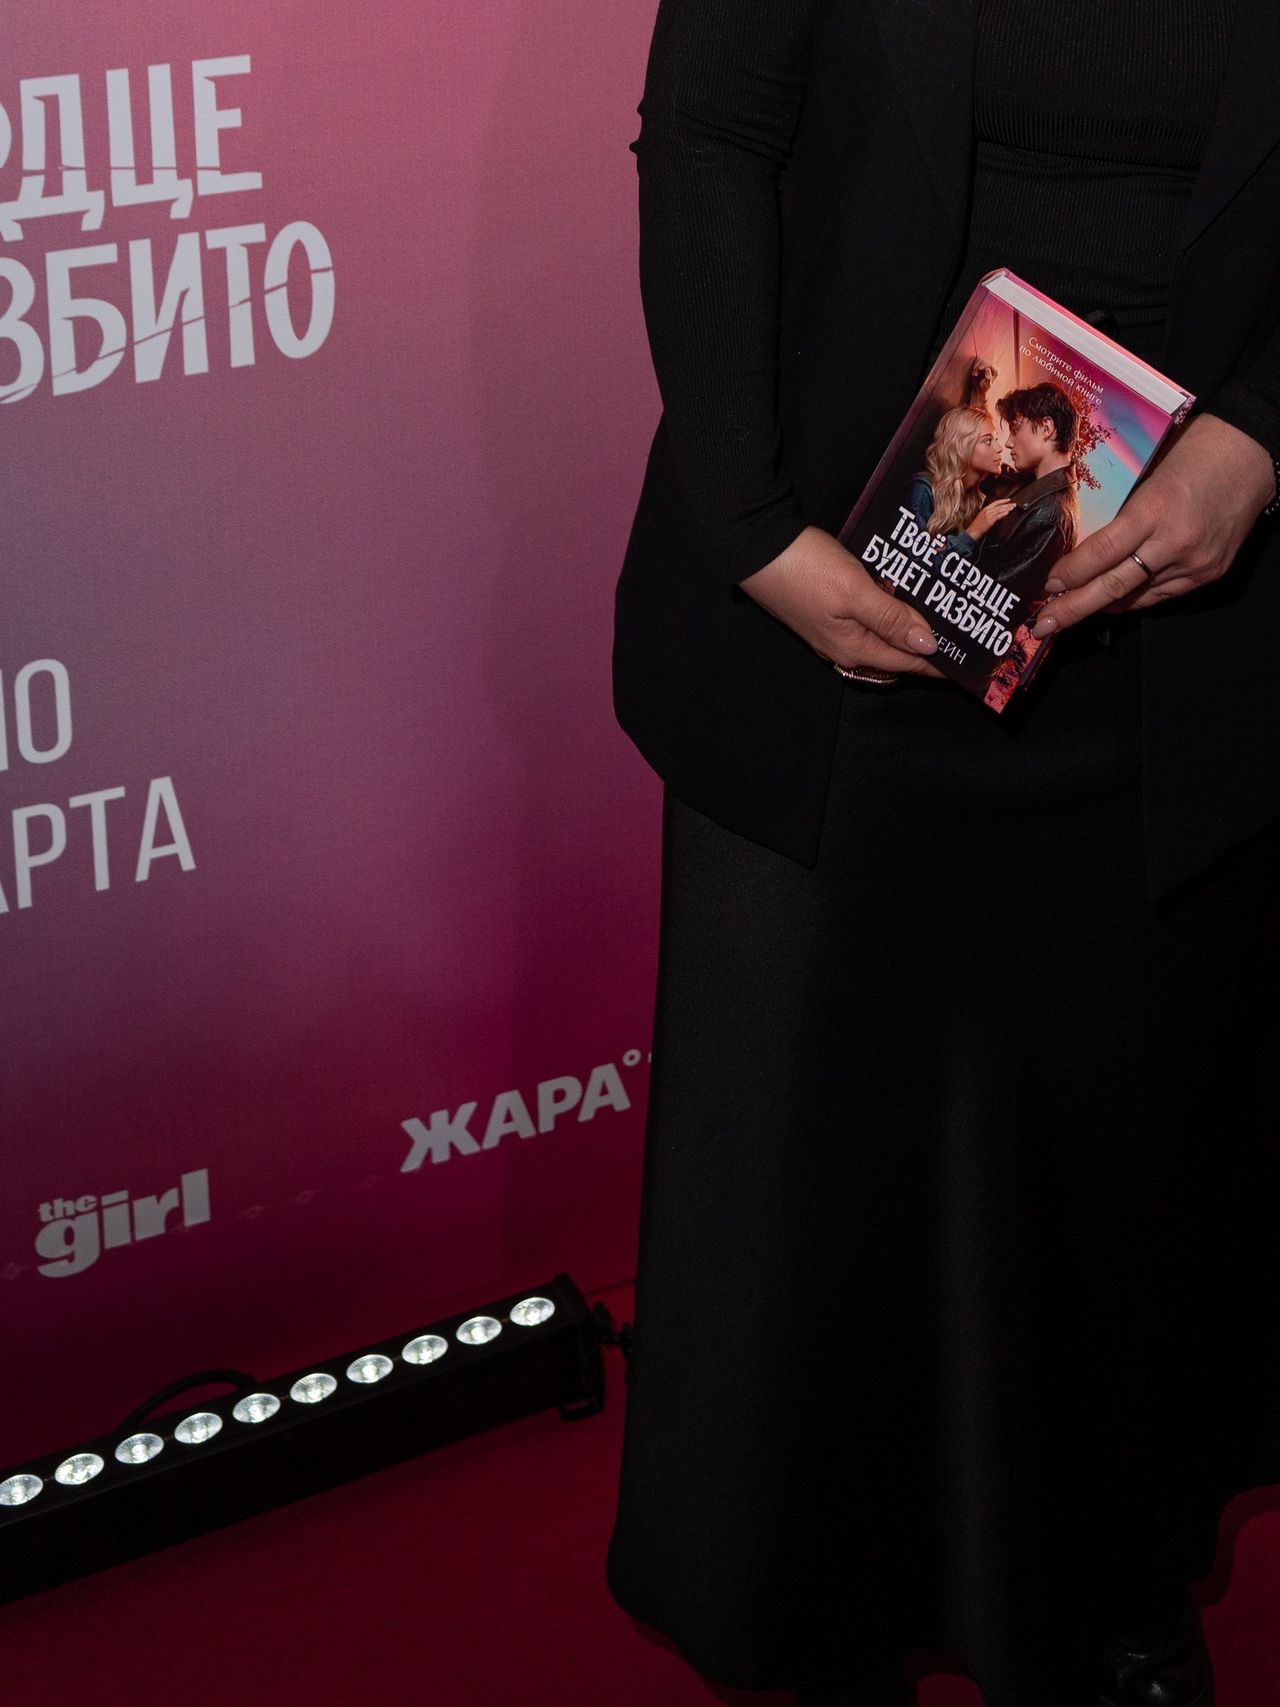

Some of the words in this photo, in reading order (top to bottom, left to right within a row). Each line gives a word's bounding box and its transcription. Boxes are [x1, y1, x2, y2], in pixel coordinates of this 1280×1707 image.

[0, 54, 263, 242] ДЦЕ
[1019, 345, 1032, 357] по
[1033, 355, 1075, 386] любимой
[1075, 384, 1102, 405] книге
[1028, 336, 1072, 372] Смотрите
[1073, 369, 1104, 394] фильм
[861, 534, 931, 597] БУДЕТ
[924, 579, 1013, 657] РАЗБИТО
[890, 505, 947, 567] ТВОЁ
[940, 551, 1020, 623] СЕРДЦЕ
[932, 630, 967, 665] ЕЙН
[35, 1168, 211, 1277] girl
[38, 1195, 97, 1222] the
